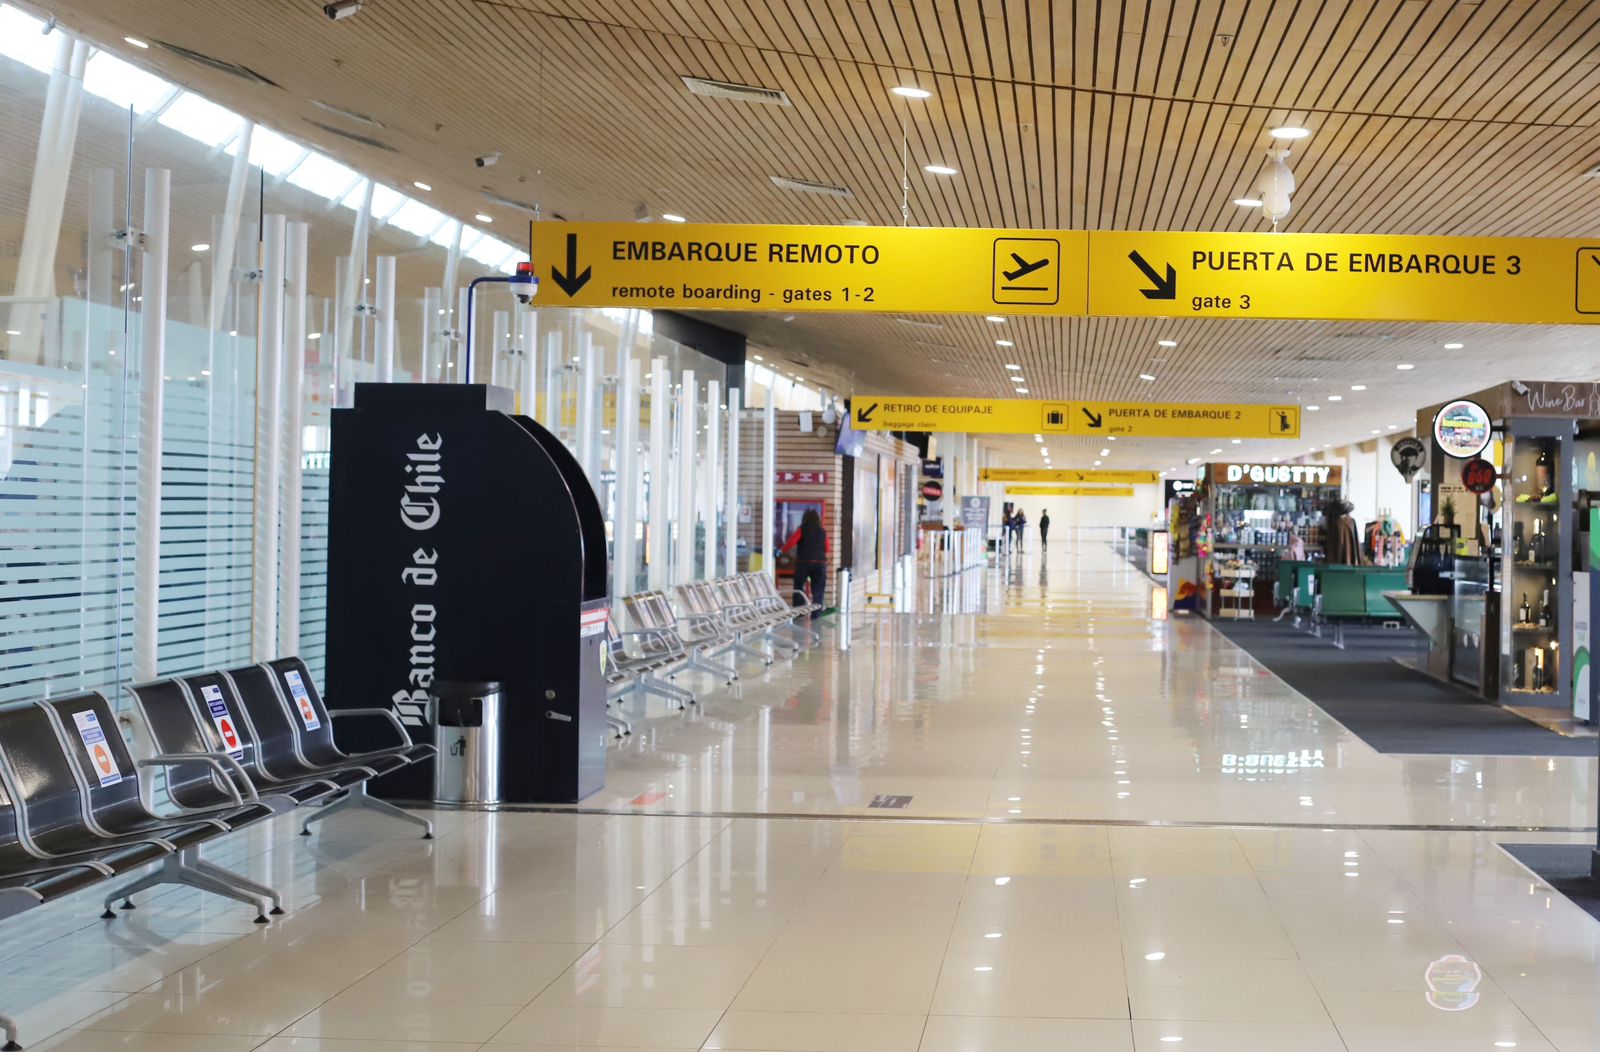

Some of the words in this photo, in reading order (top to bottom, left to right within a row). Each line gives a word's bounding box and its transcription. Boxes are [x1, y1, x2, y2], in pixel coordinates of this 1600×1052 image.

[612, 240, 758, 263] EMBARQUE
[768, 242, 880, 265] REMOTO
[1192, 250, 1295, 271] PUERTA
[1305, 252, 1339, 272] DE
[1349, 253, 1497, 275] EMBARQUE
[1505, 255, 1522, 275] 3
[611, 284, 676, 299] remote
[682, 283, 761, 304] boarding
[782, 287, 832, 304] gates
[1191, 295, 1232, 312] gate
[1239, 294, 1251, 310] 3
[1527, 383, 1563, 411] Wine
[1562, 384, 1586, 411] Bar
[883, 403, 922, 414] RETIRO
[924, 404, 939, 414] DE
[941, 404, 993, 415] EQUIPAJE
[1108, 408, 1151, 418] PUERTA
[1154, 409, 1168, 419] DE
[1171, 409, 1231, 420] EMBARQUE
[1234, 410, 1242, 420] 2
[882, 420, 915, 429] baggage
[916, 420, 937, 429] claim
[400, 431, 446, 531] Chile
[1227, 464, 1330, 484] D'GUSTTY
[401, 546, 440, 586] de
[391, 603, 437, 728] Banco
